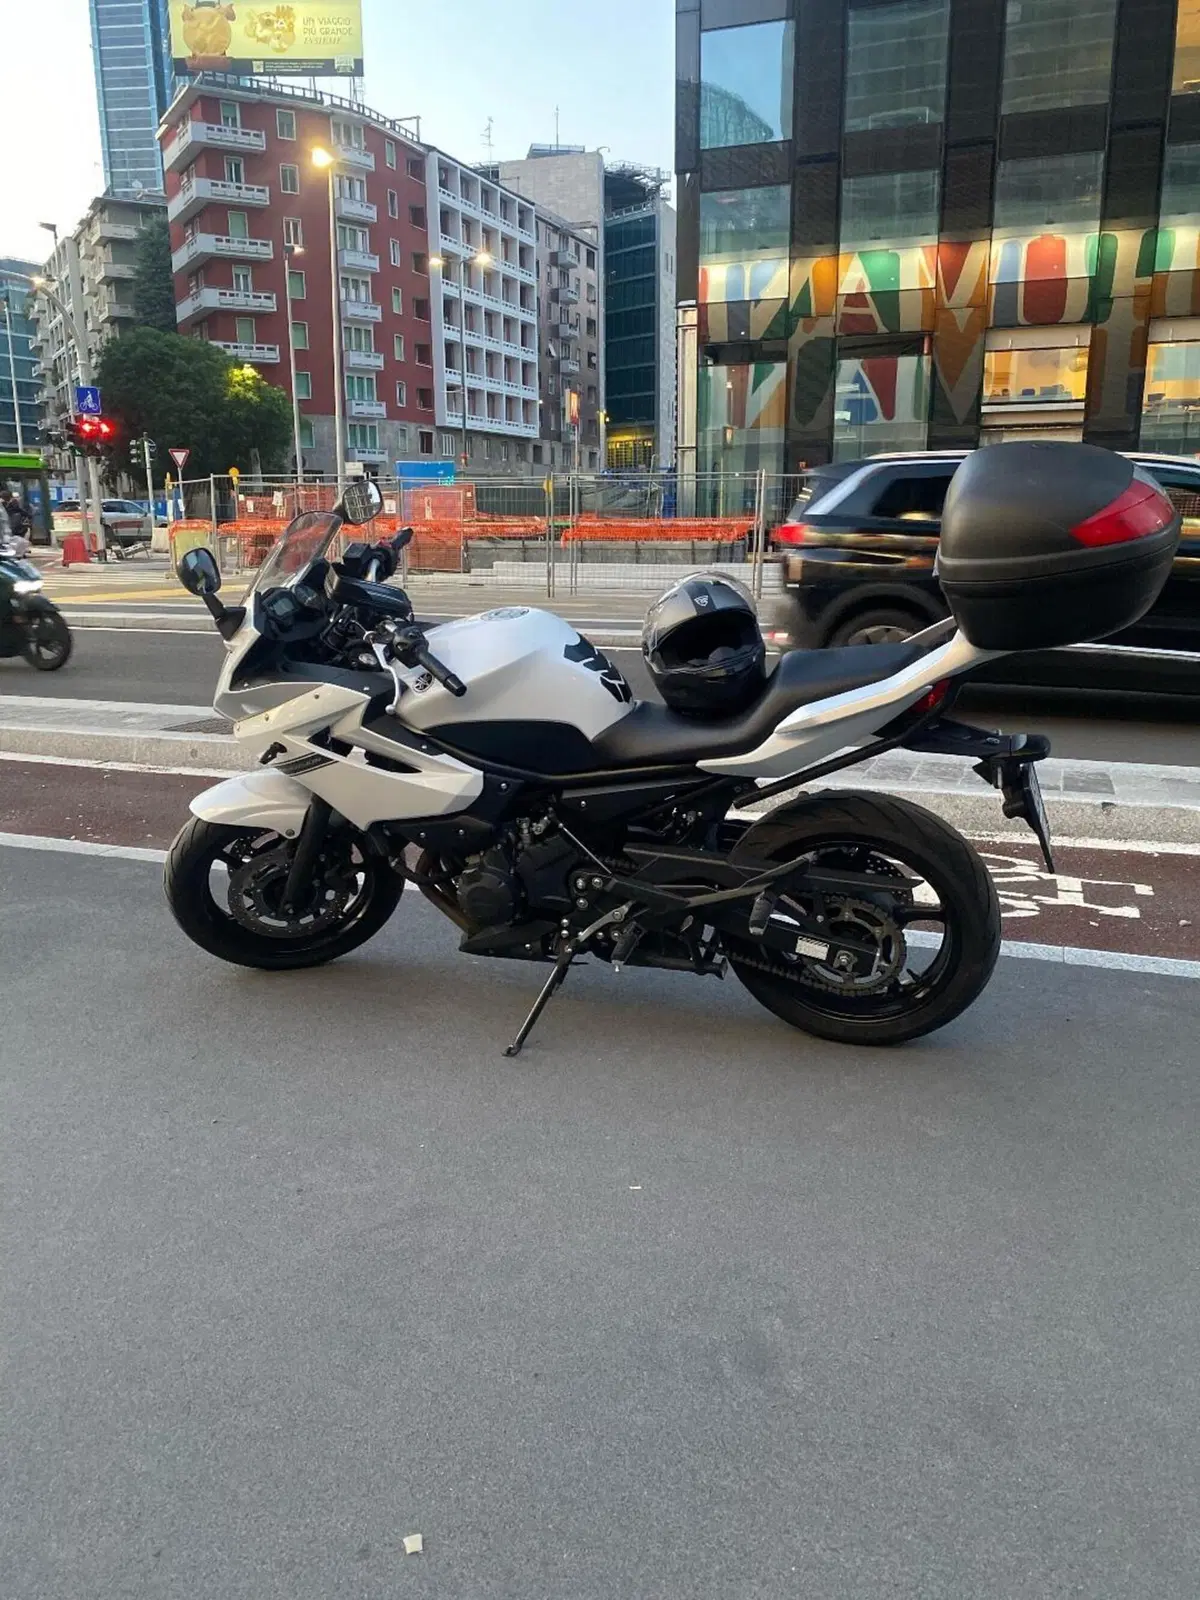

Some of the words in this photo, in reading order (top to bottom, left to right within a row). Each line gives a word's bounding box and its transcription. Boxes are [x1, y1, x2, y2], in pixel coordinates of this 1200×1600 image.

[302, 16, 315, 26] UN
[317, 16, 351, 26] VIAGGIO
[319, 27, 353, 36] GRANDE
